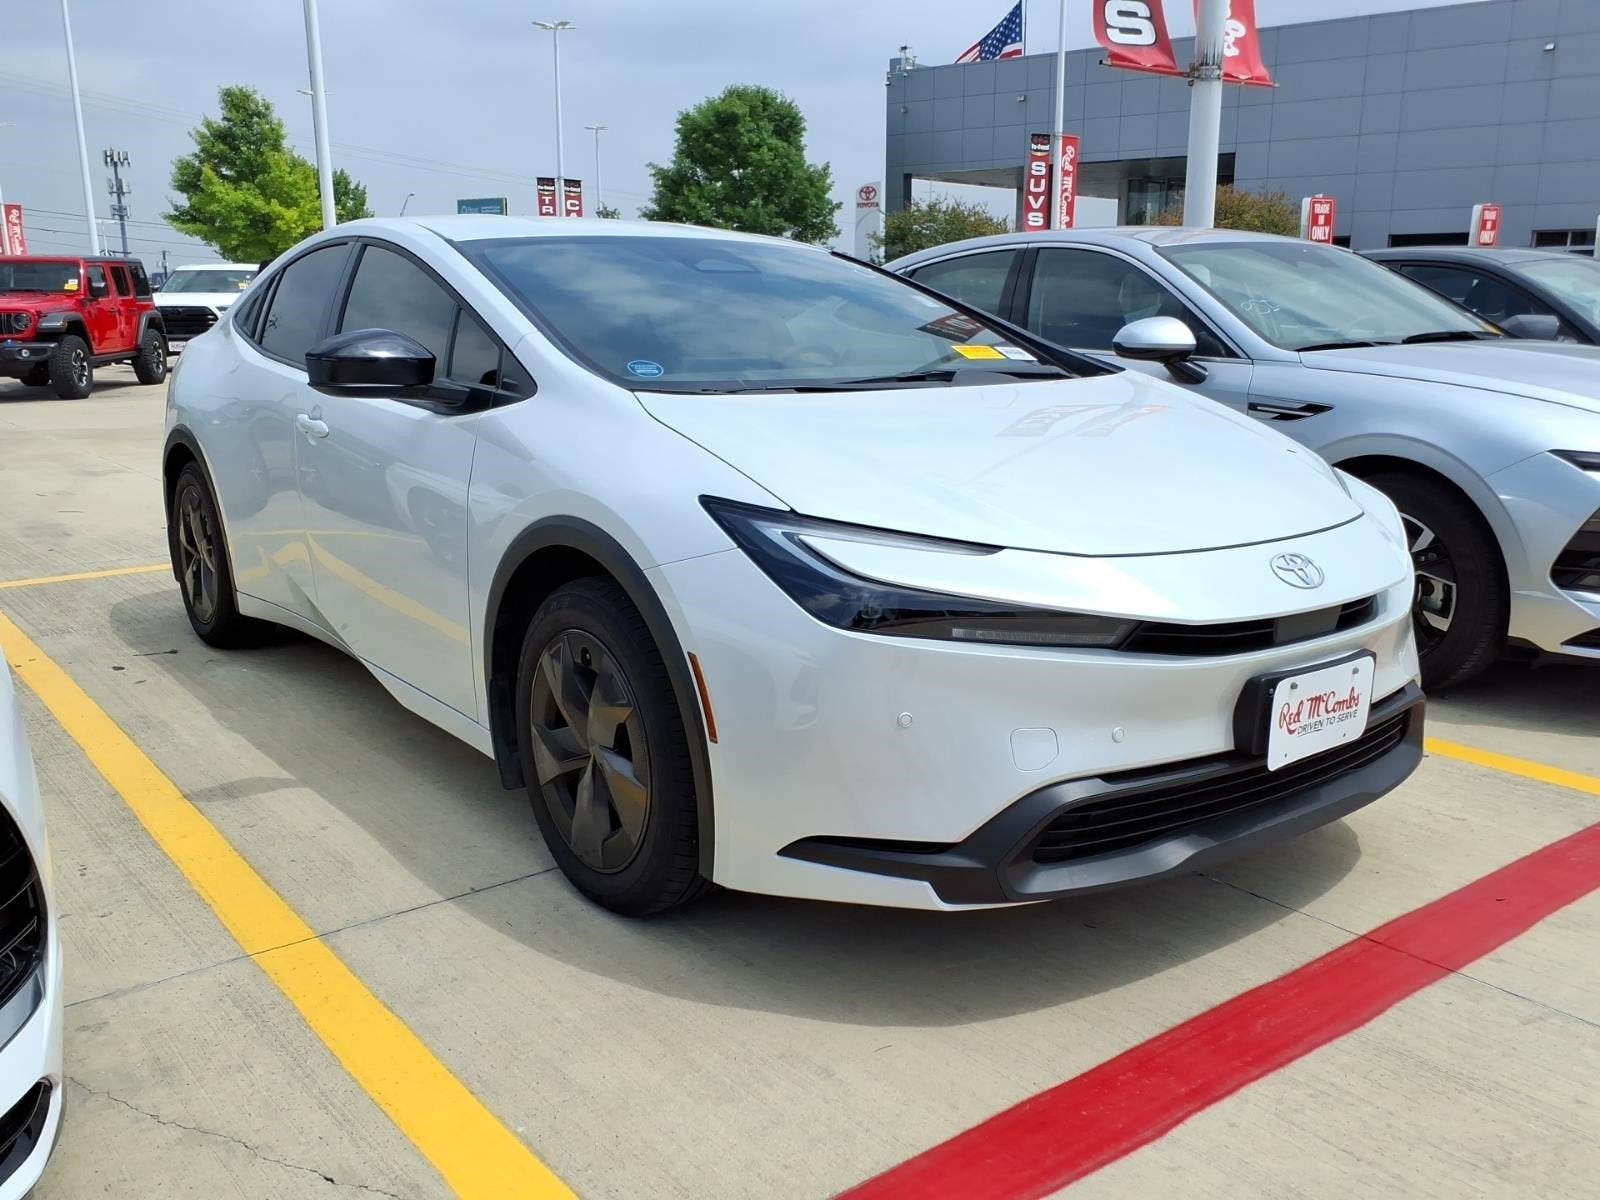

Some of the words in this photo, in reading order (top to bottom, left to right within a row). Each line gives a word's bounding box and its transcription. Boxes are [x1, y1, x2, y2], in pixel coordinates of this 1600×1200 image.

[1104, 0, 1157, 46] S
[1062, 145, 1075, 172] Red
[1027, 161, 1046, 226] SUVS
[1311, 226, 1330, 241] ONLY
[1279, 702, 1304, 735] Red
[1307, 686, 1360, 719] McCombs
[1297, 719, 1324, 735] DRIVEN
[1326, 716, 1336, 726] TO
[1337, 709, 1358, 723] SERVE
